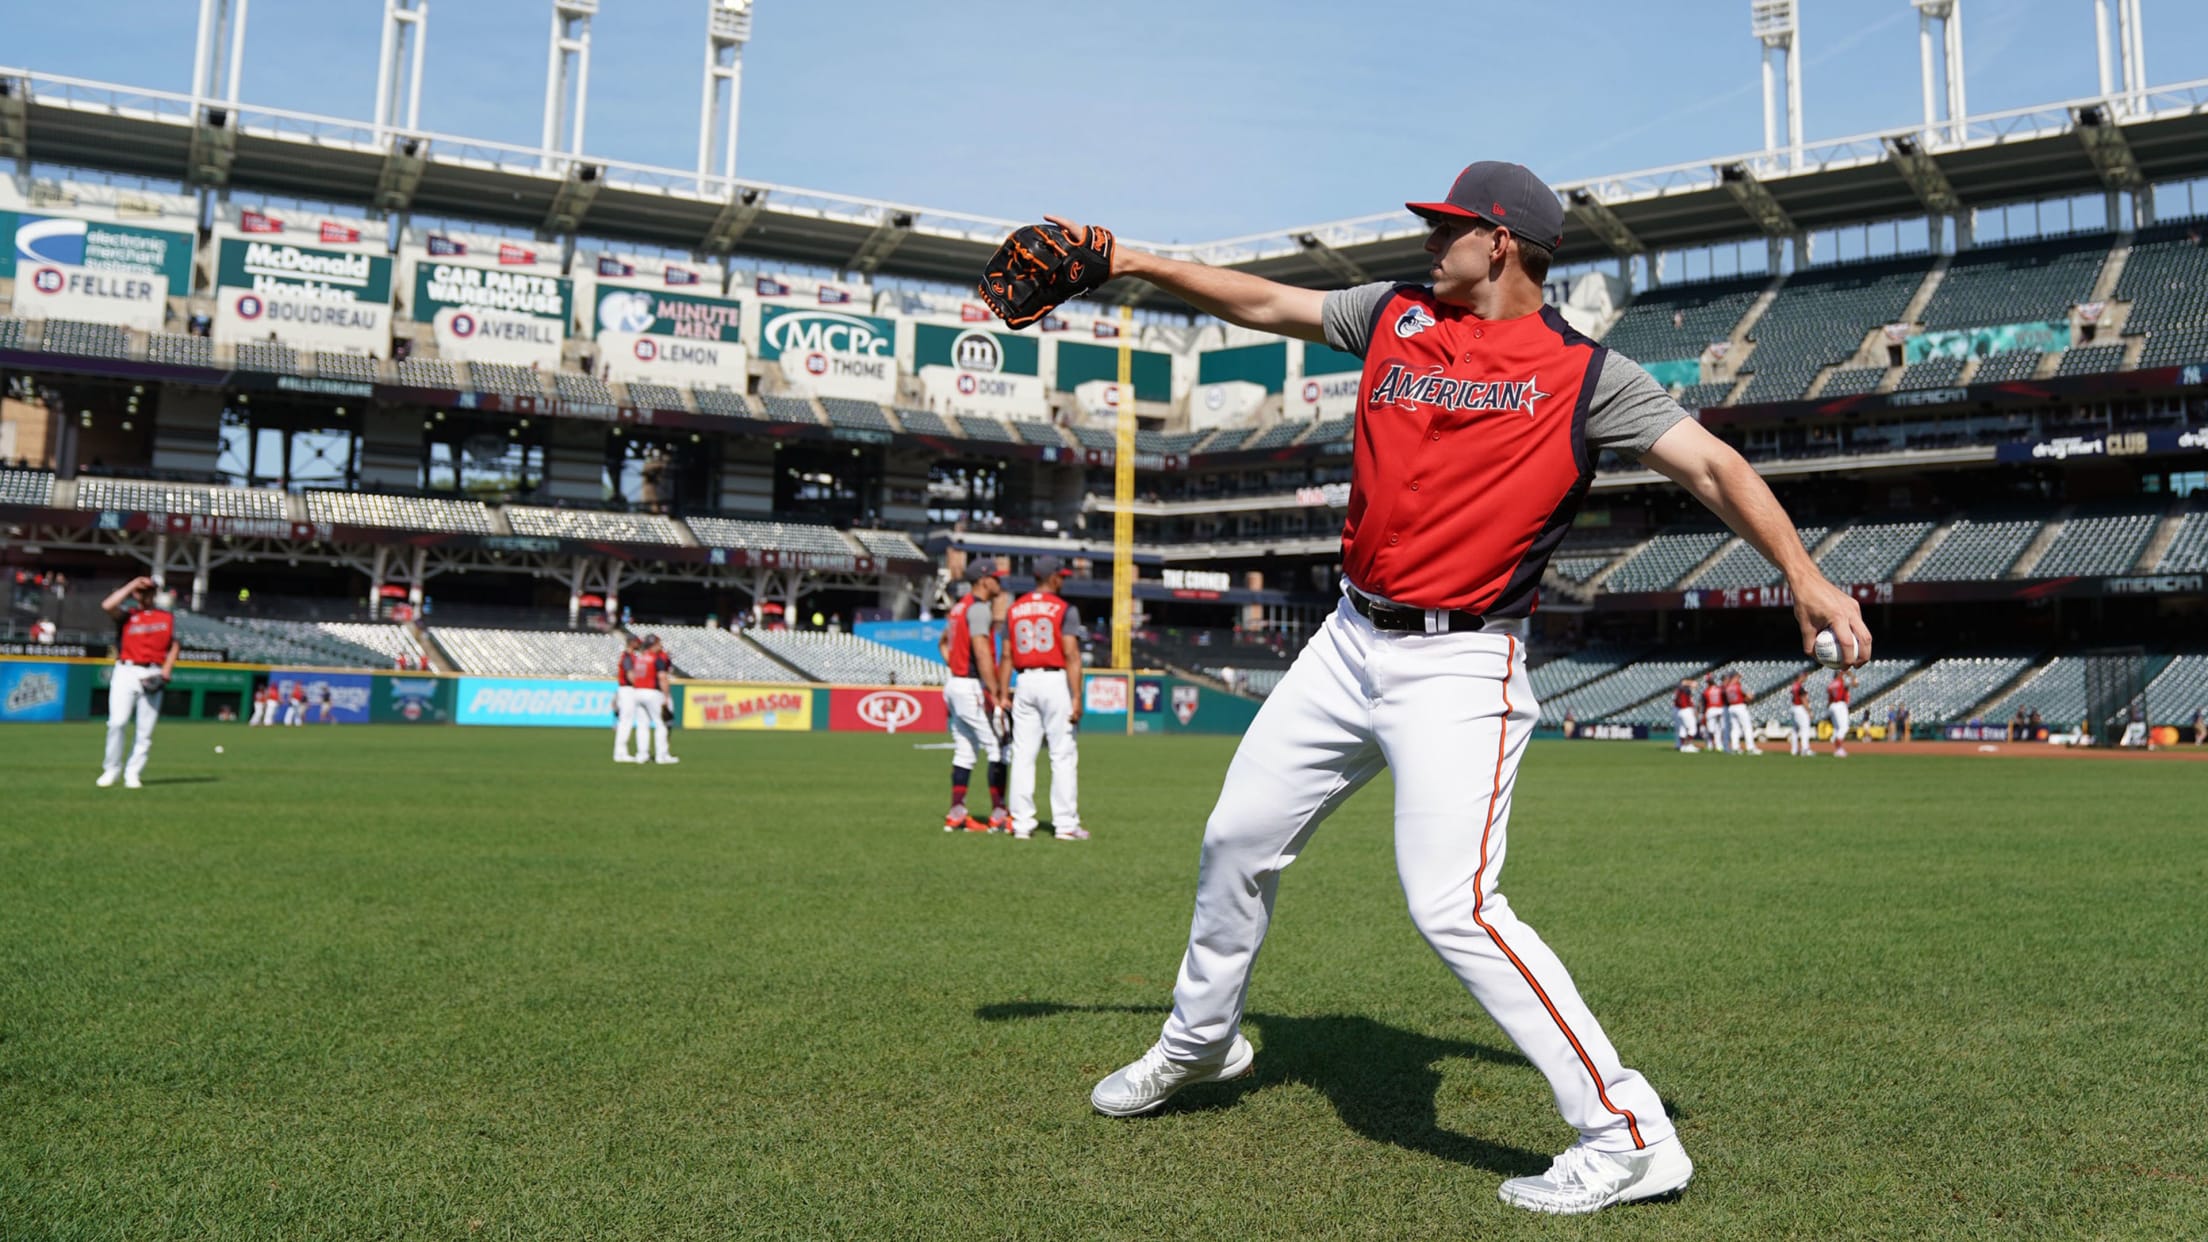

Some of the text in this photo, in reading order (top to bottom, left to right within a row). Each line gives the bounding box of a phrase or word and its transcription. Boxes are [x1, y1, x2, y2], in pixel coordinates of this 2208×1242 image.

[86, 230, 168, 249] electronic
[85, 244, 165, 267] merchant
[244, 242, 370, 279] McDonald
[69, 273, 153, 300] FELLER
[433, 265, 558, 297] CAR PARTS
[426, 280, 563, 315] WAREHOUSE
[267, 302, 377, 328] BOUDREAU
[656, 299, 739, 327] MINUTE
[479, 320, 555, 345] AVERILL
[673, 319, 722, 341] MEN
[659, 344, 719, 366] LEMON
[831, 358, 885, 380] THOME
[978, 378, 1017, 397] DOBY
[1370, 364, 1526, 412] AMERICAN
[2105, 432, 2149, 455] CLUB
[1014, 617, 1055, 655] 88
